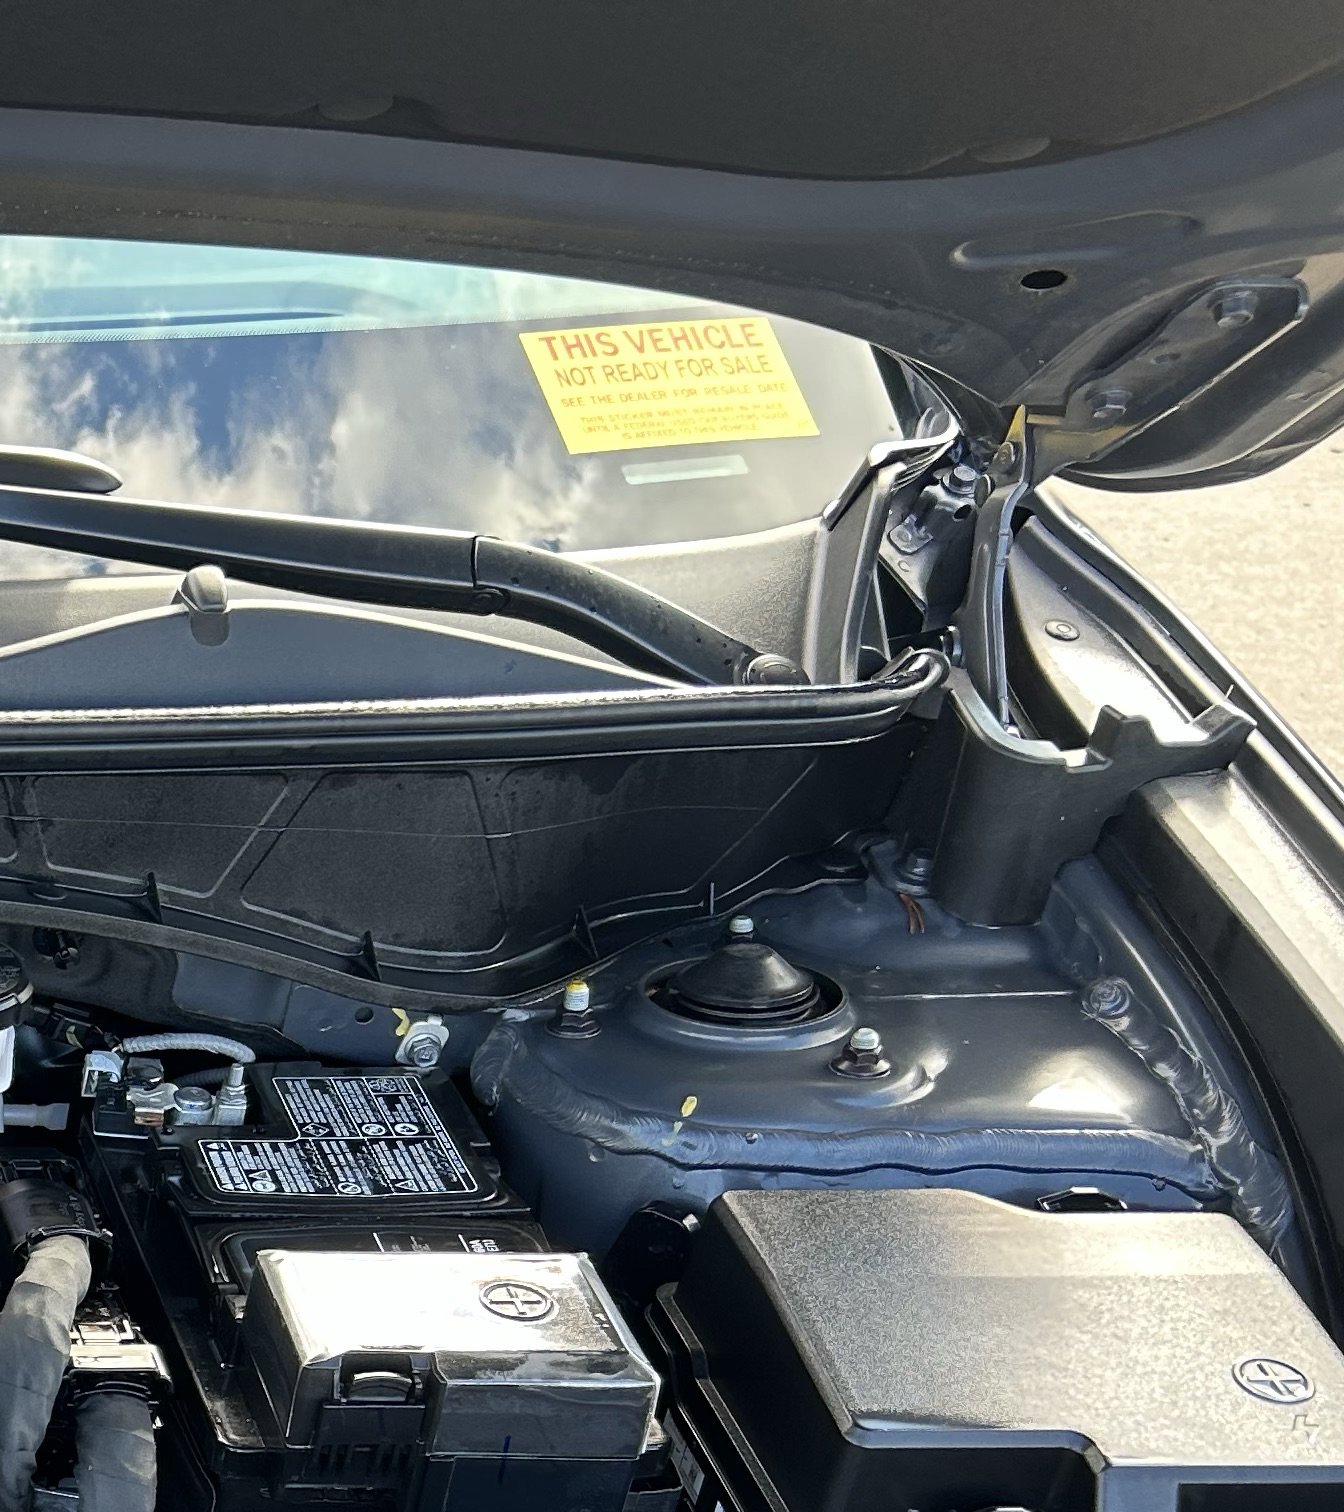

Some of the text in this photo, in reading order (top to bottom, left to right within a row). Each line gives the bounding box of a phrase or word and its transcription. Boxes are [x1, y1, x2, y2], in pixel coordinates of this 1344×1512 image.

[538, 323, 762, 359] THIS VEHICLE
[553, 355, 772, 386] NOT READY FOR SALE
[559, 381, 787, 407] SEE THE DEALER FOR RESALE DATE
